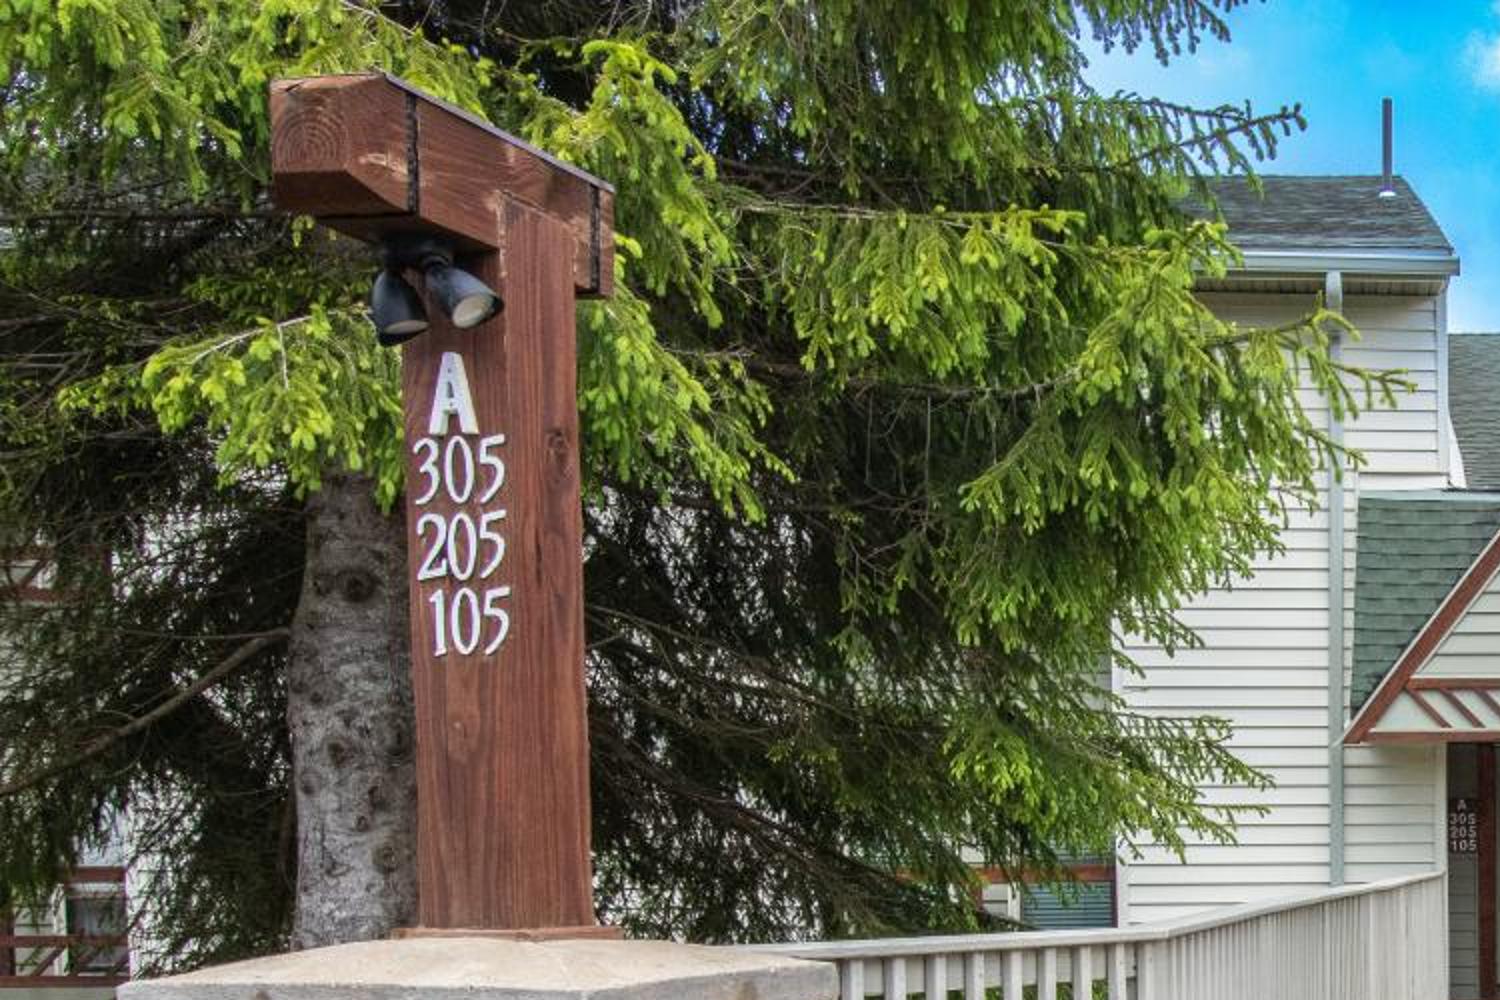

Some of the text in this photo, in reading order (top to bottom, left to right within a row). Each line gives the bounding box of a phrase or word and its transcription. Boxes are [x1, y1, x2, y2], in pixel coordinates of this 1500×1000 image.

[428, 351, 479, 435] A
[412, 433, 506, 505] 305
[416, 509, 508, 581] 205
[428, 586, 511, 657] 105
